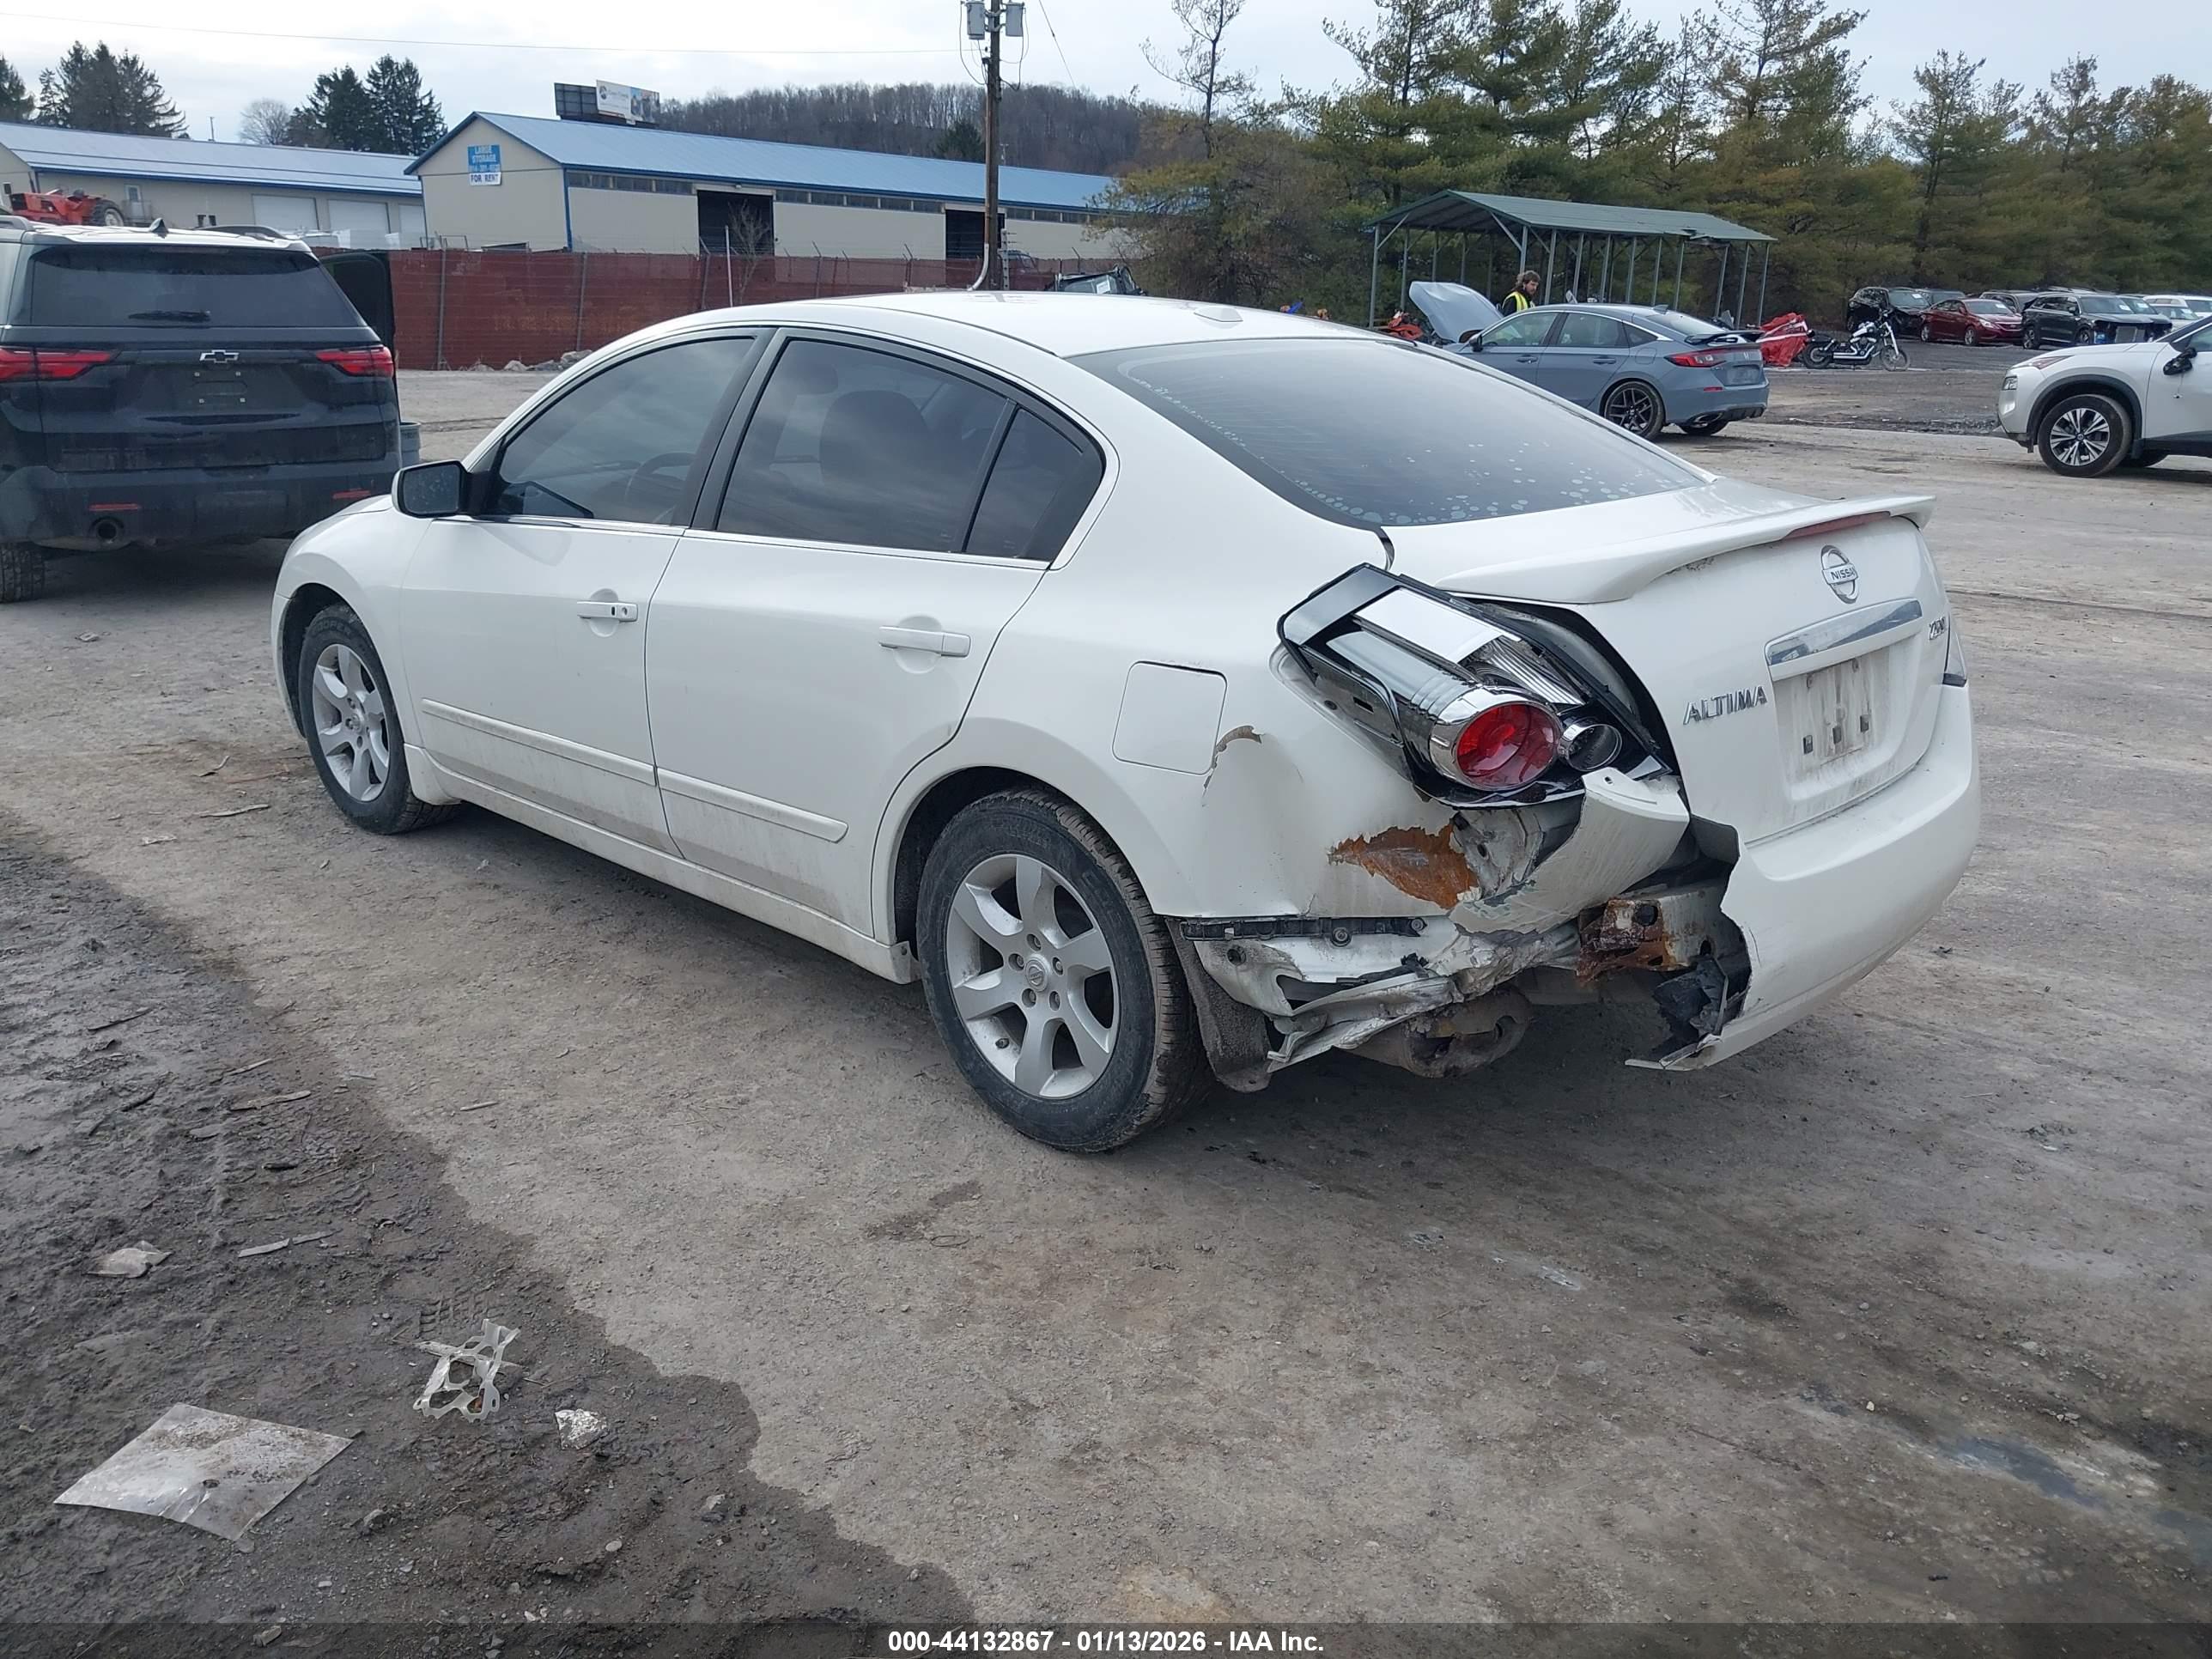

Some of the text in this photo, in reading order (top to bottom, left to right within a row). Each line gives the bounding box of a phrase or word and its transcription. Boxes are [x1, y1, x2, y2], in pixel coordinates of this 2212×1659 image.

[471, 173, 499, 184] FOR RENT
[1830, 566, 1856, 580] NISSA
[1682, 684, 1767, 726] ALTIMA
